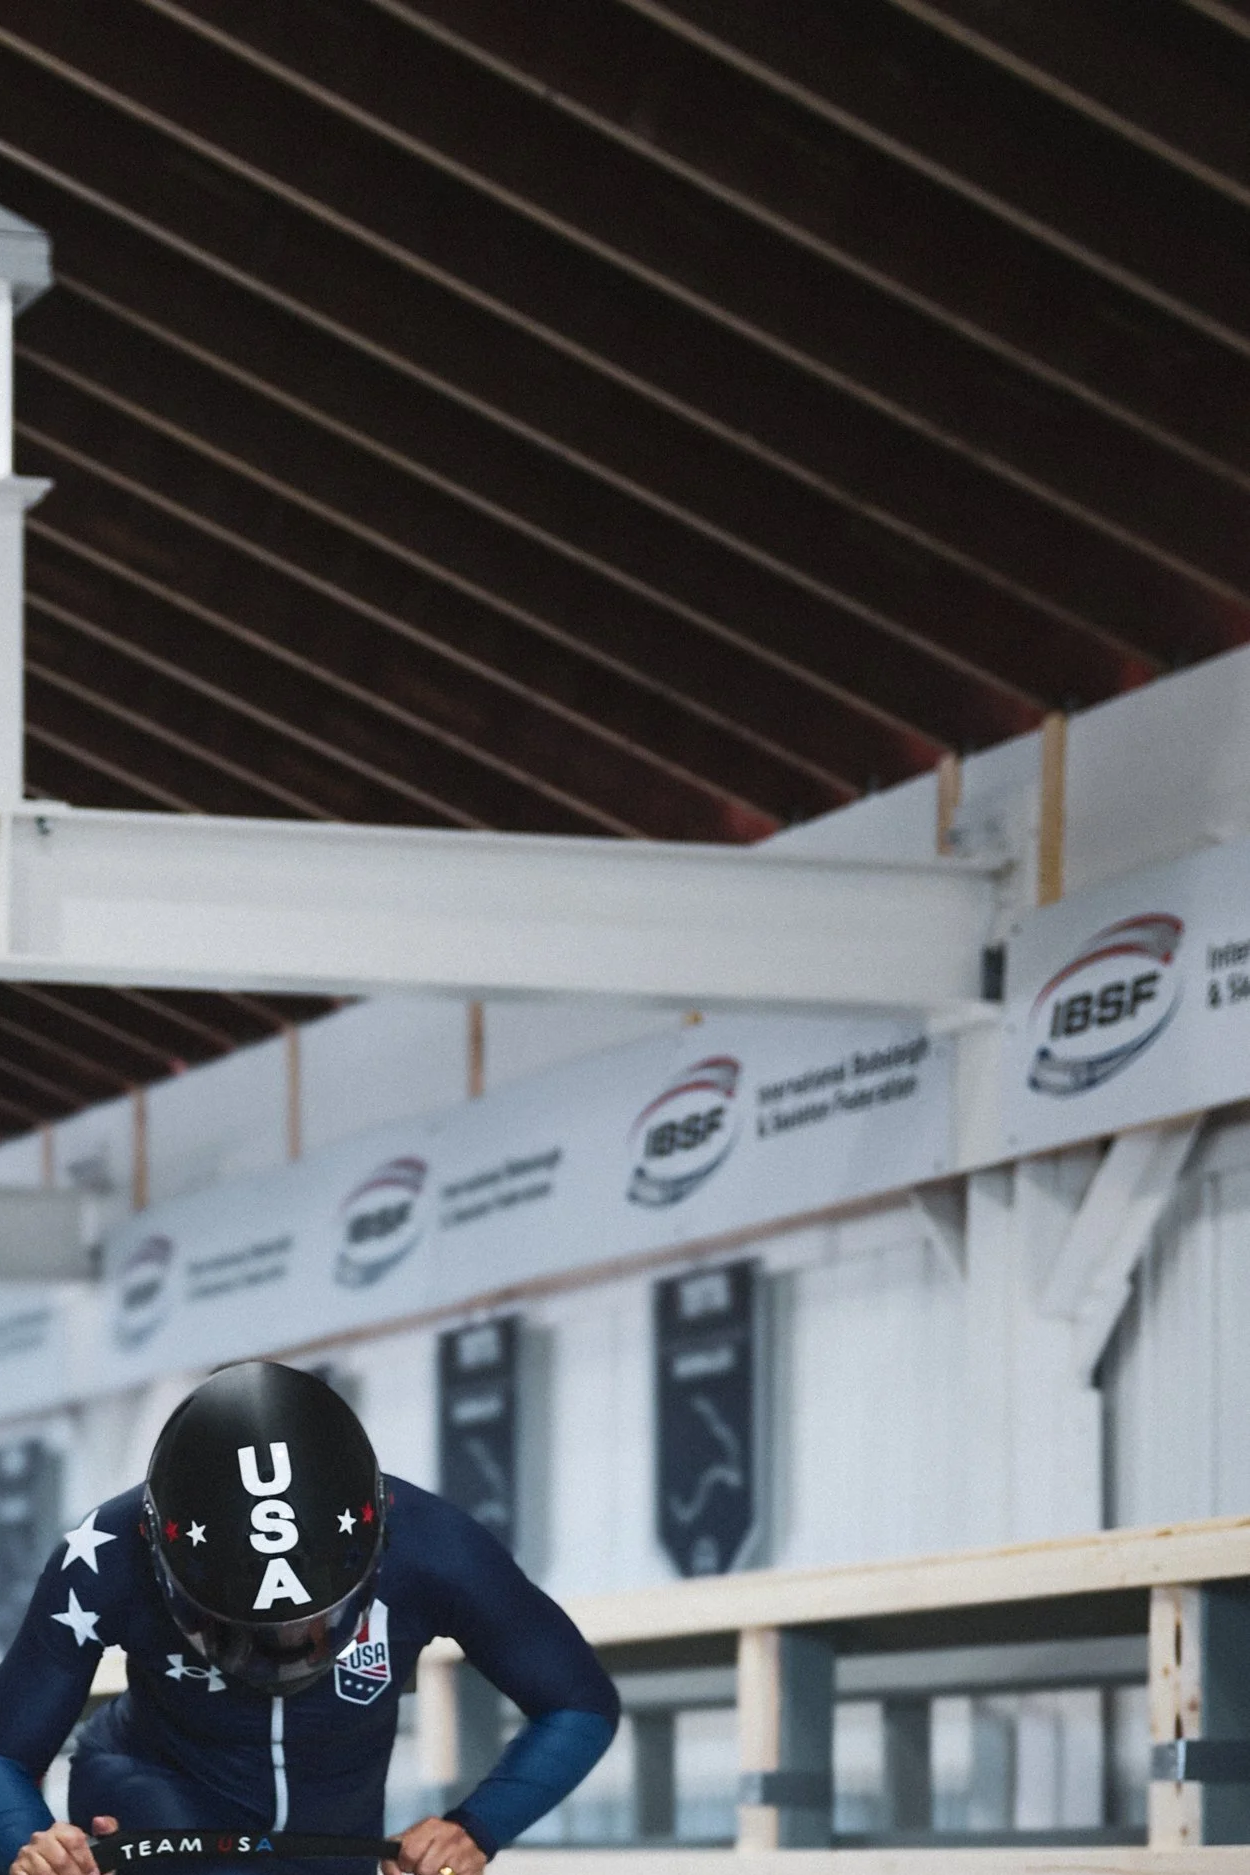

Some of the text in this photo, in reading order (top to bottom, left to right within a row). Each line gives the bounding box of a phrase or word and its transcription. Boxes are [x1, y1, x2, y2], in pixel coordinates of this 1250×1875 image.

[1049, 969, 1161, 1042] IBSF
[644, 1105, 725, 1159] IBSF
[237, 1441, 312, 1610] USA
[350, 1642, 387, 1669] USA
[120, 1836, 275, 1860] TEAM USA
